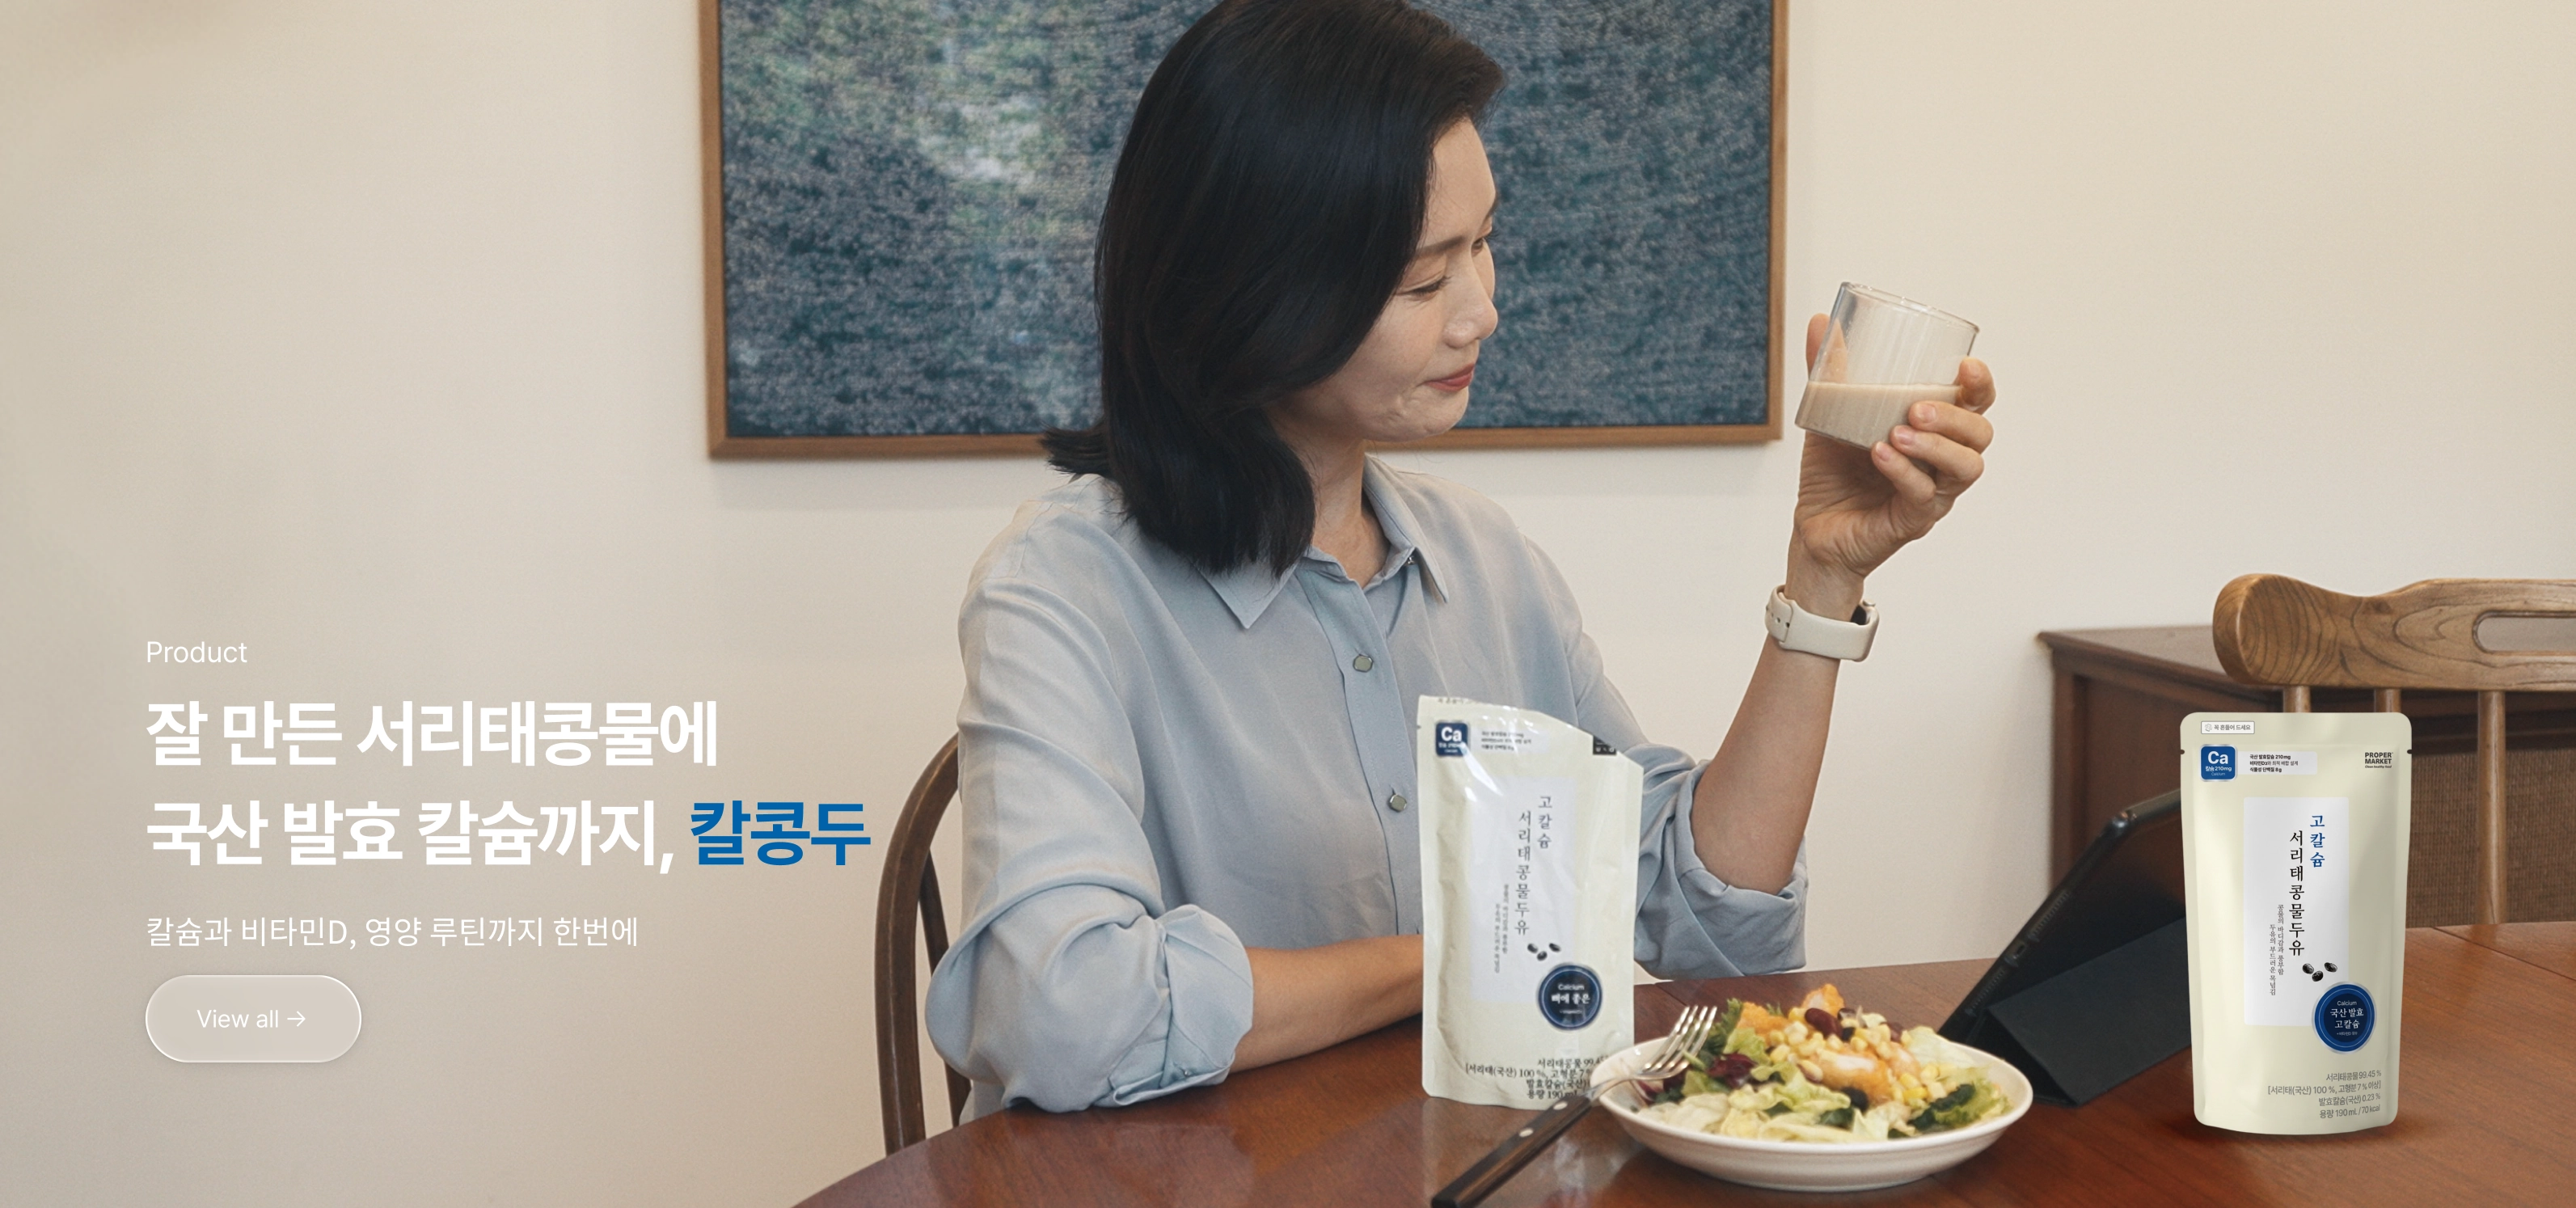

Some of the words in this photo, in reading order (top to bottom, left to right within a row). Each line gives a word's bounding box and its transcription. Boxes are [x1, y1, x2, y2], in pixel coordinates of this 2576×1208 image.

[1441, 726, 1463, 742] Ca
[2207, 750, 2229, 764] Ca
[1537, 796, 1552, 849] 고칼슘
[2310, 815, 2326, 868] 고칼슘
[1514, 810, 1531, 936] 서리태콩물두유
[2289, 830, 2305, 957] 서리태콩물두유
[2330, 1008, 2347, 1018] 국산
[2349, 1008, 2364, 1018] 발효
[2335, 1020, 2360, 1029] 고칼슘
[1520, 1069, 1535, 1078] 100
[2326, 1072, 2359, 1082] 서리태콩물
[2359, 1070, 2375, 1079] 99.45
[2268, 1086, 2312, 1096] [서리태(국산)
[2313, 1086, 2327, 1094] 100
[2329, 1086, 2337, 1095] %,
[2338, 1083, 2357, 1093] 고형분
[2363, 1083, 2367, 1091] %
[2368, 1080, 2381, 1090] 이상]
[2319, 1095, 2362, 1107] 발효칼슘(국산)
[2363, 1093, 2375, 1102] 0.23
[2320, 1109, 2333, 1119] 용량
[2335, 1109, 2348, 1117] 190
[2362, 1106, 2369, 1114] 70
[2370, 1105, 2380, 1113] kcal
